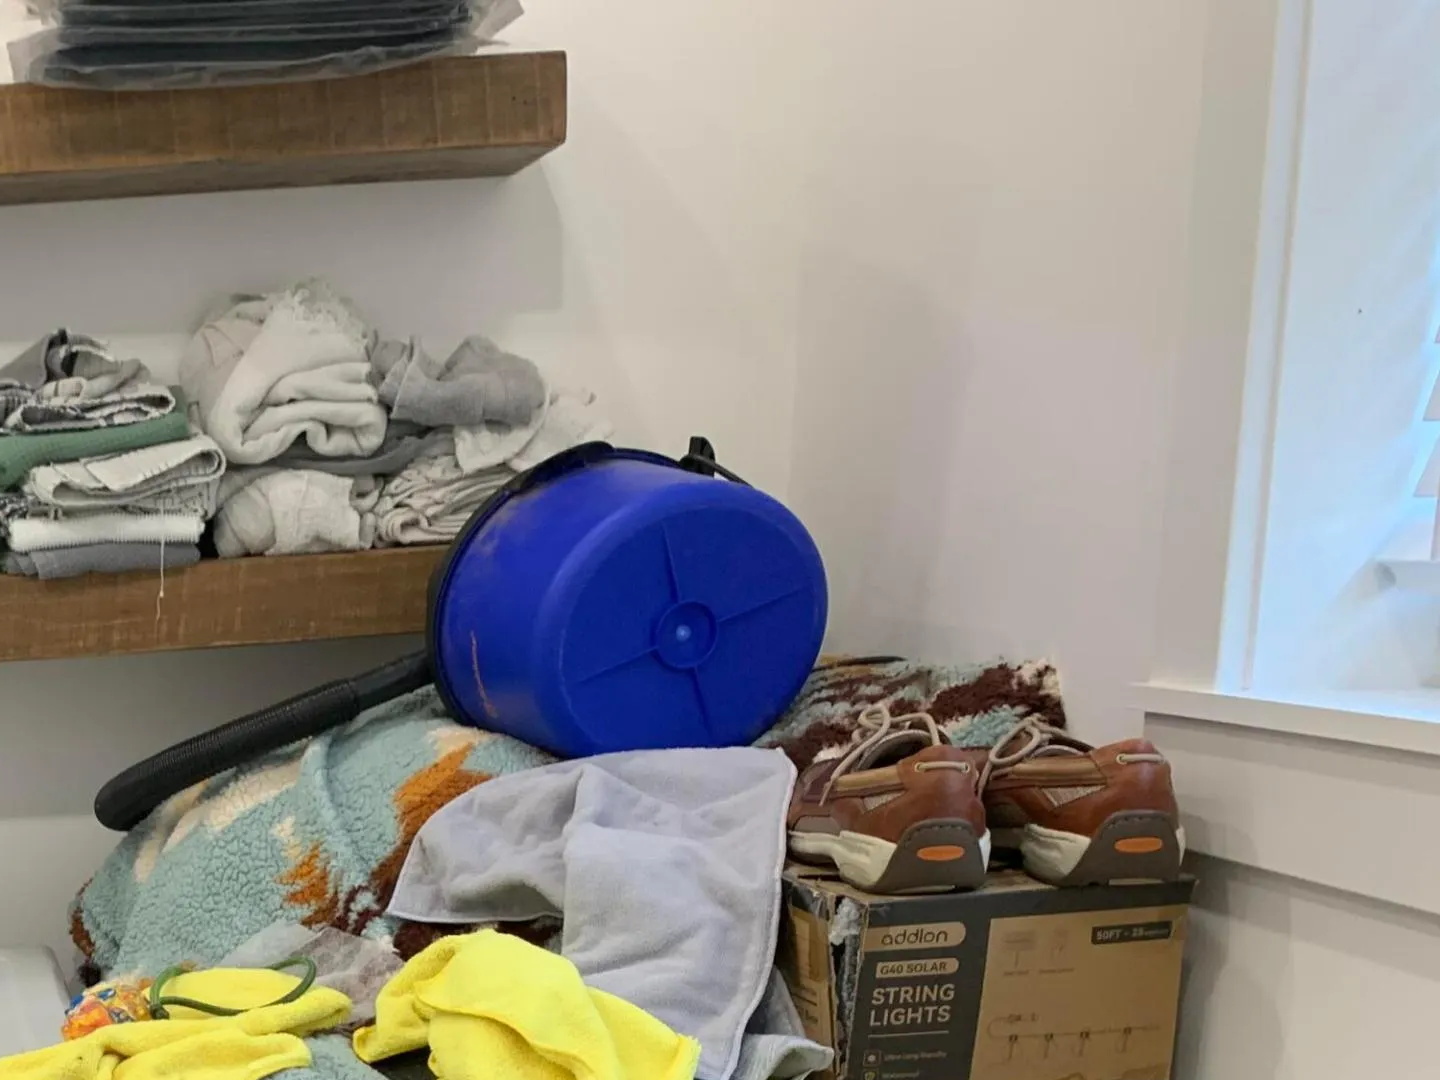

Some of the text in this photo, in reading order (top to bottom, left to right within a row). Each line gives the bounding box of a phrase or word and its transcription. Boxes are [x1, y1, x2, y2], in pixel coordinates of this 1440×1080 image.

[880, 961, 948, 975] G40 SOLAR
[871, 984, 955, 1005] STRING
[869, 1005, 951, 1026] LIGHTS
